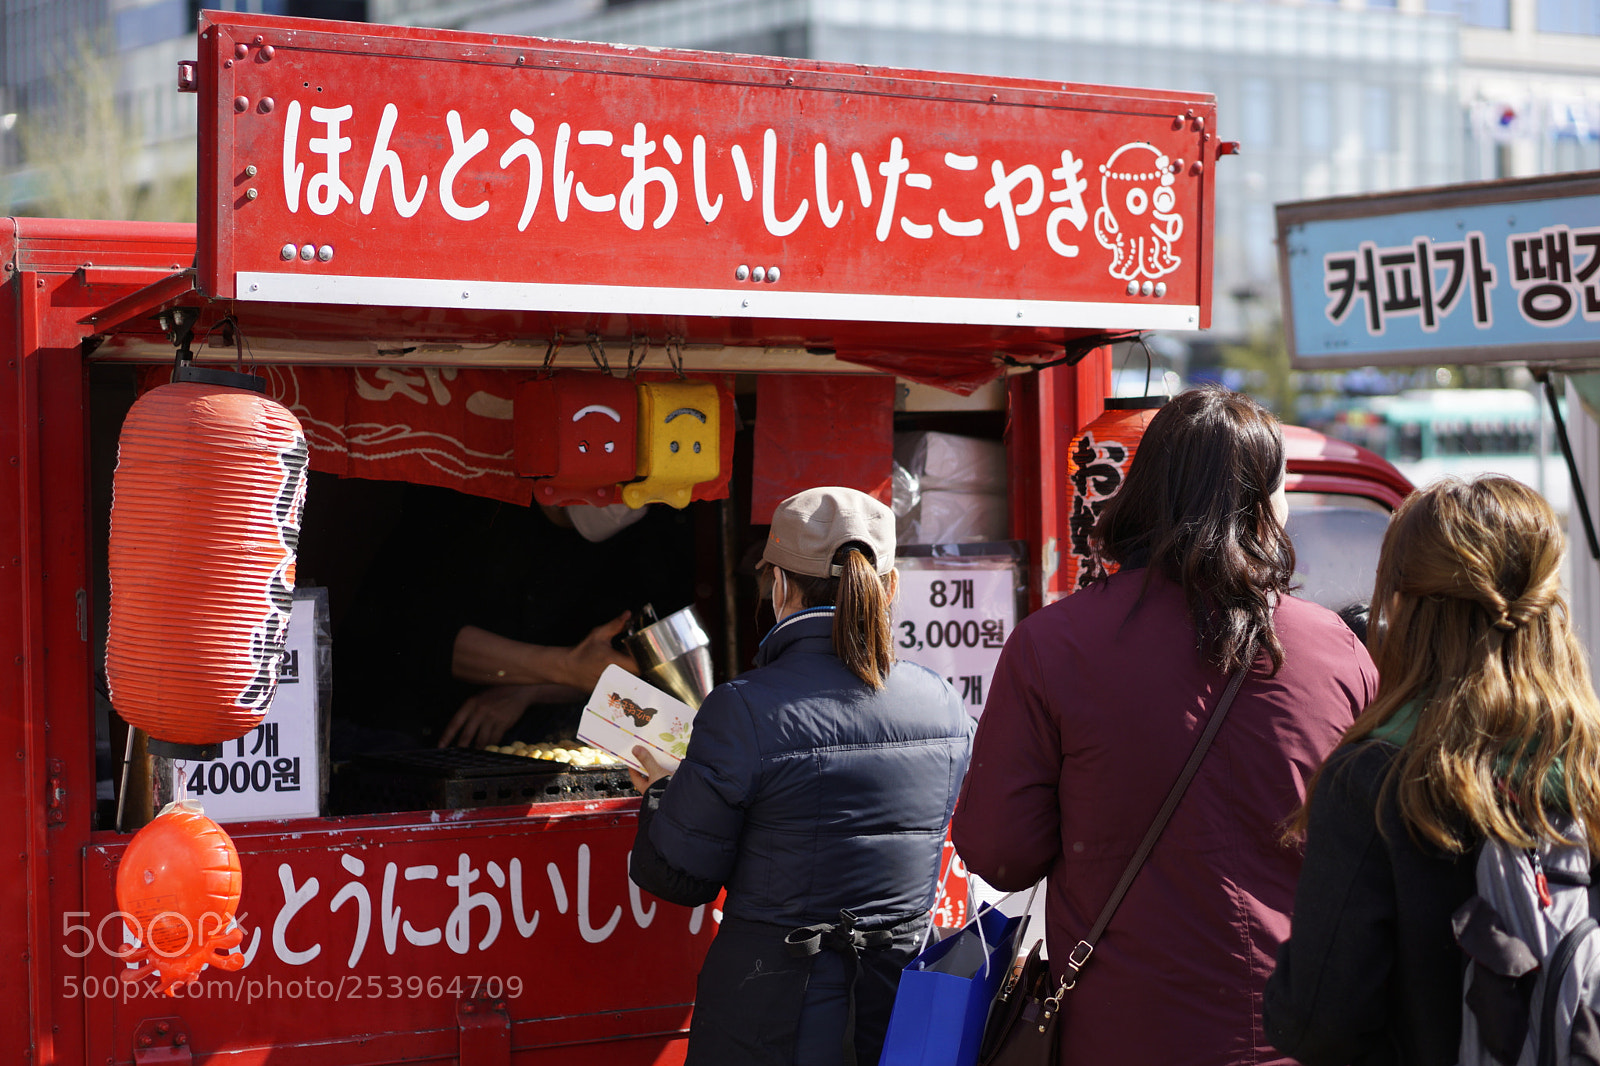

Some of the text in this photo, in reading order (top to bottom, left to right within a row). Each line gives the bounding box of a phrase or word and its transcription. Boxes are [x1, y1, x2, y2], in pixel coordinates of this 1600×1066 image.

[283, 100, 1089, 258] ほんとうにおいしいたこやき
[1326, 234, 1494, 333] 커피가
[930, 579, 974, 609] 8개
[898, 619, 1004, 651] 3,000원
[187, 756, 300, 796] 4000원
